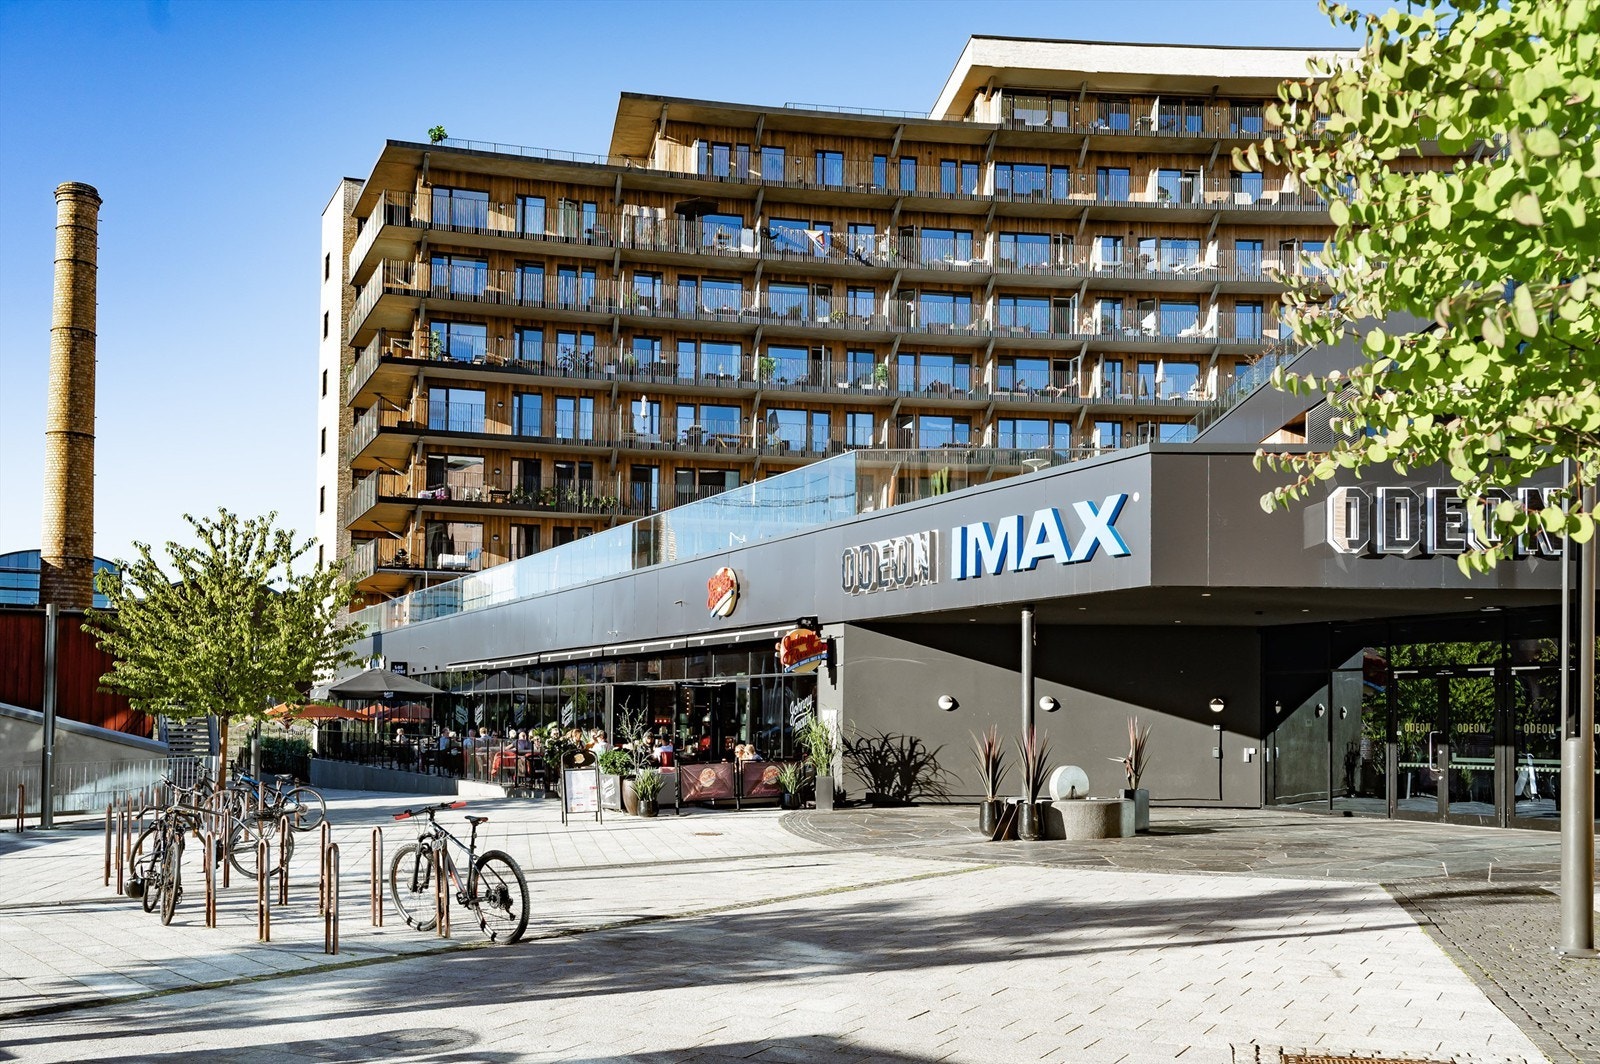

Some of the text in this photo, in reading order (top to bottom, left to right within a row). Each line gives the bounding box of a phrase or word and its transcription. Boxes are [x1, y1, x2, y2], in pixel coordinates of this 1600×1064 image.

[841, 493, 1132, 596] ODEON IMAX
[1404, 722, 1432, 733] ODEON
[1457, 722, 1486, 733] ODEON
[1523, 723, 1555, 734] ODEON
